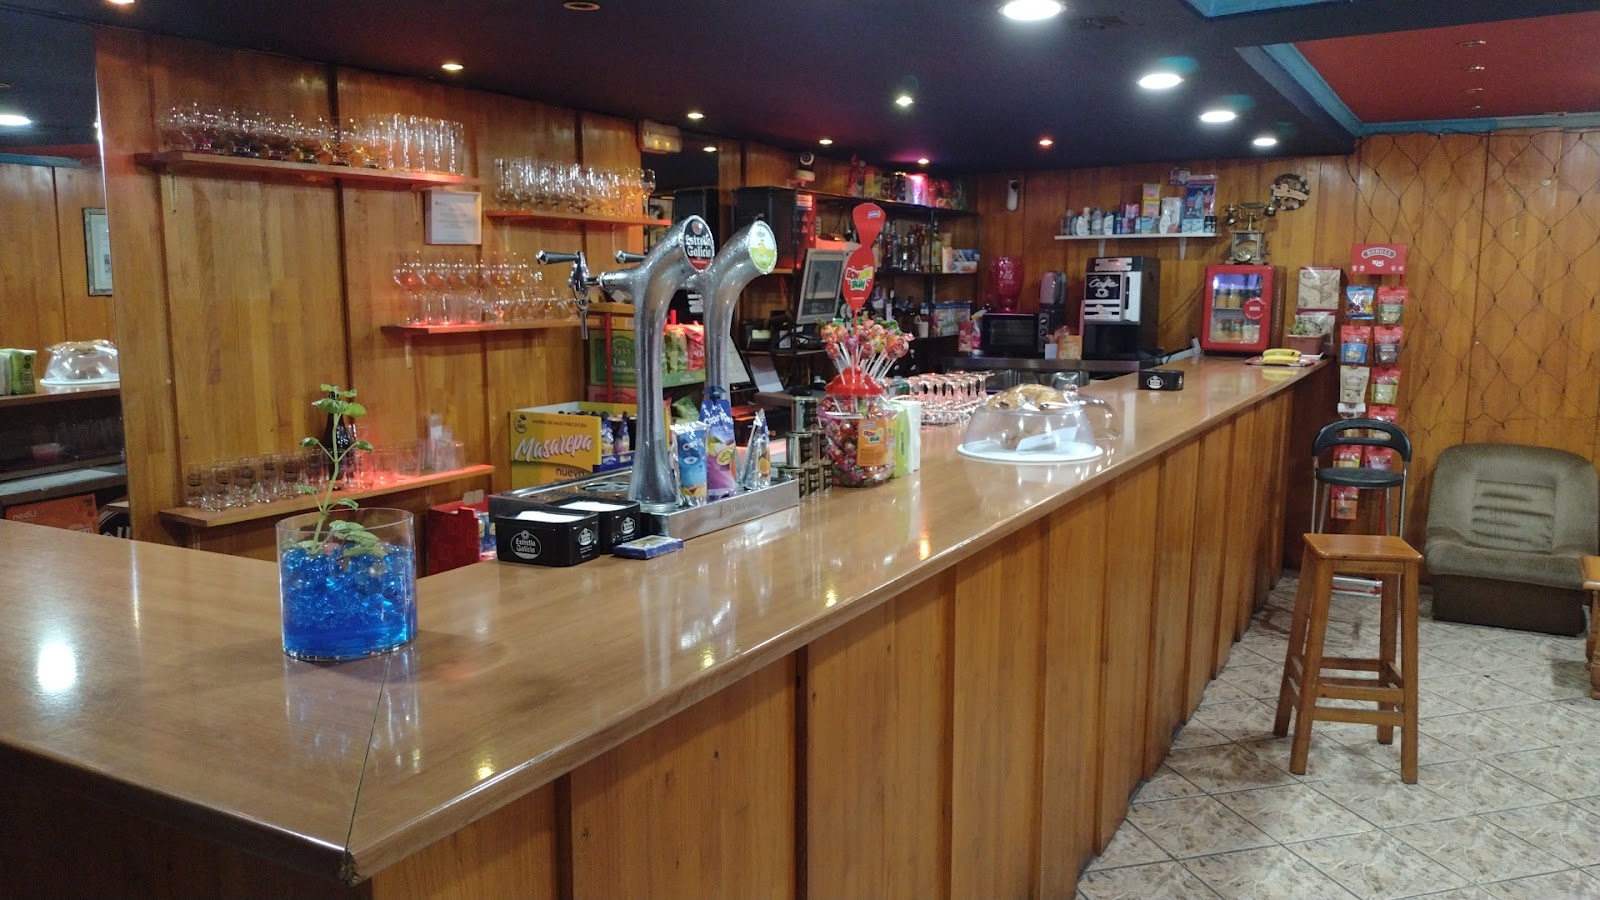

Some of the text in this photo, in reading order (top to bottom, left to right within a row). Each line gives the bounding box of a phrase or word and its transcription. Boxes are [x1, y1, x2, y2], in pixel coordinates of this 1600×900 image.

[685, 233, 712, 246] Estrella
[686, 245, 712, 258] Galicia
[514, 433, 592, 463] Masarepa
[515, 537, 536, 547] Estrella
